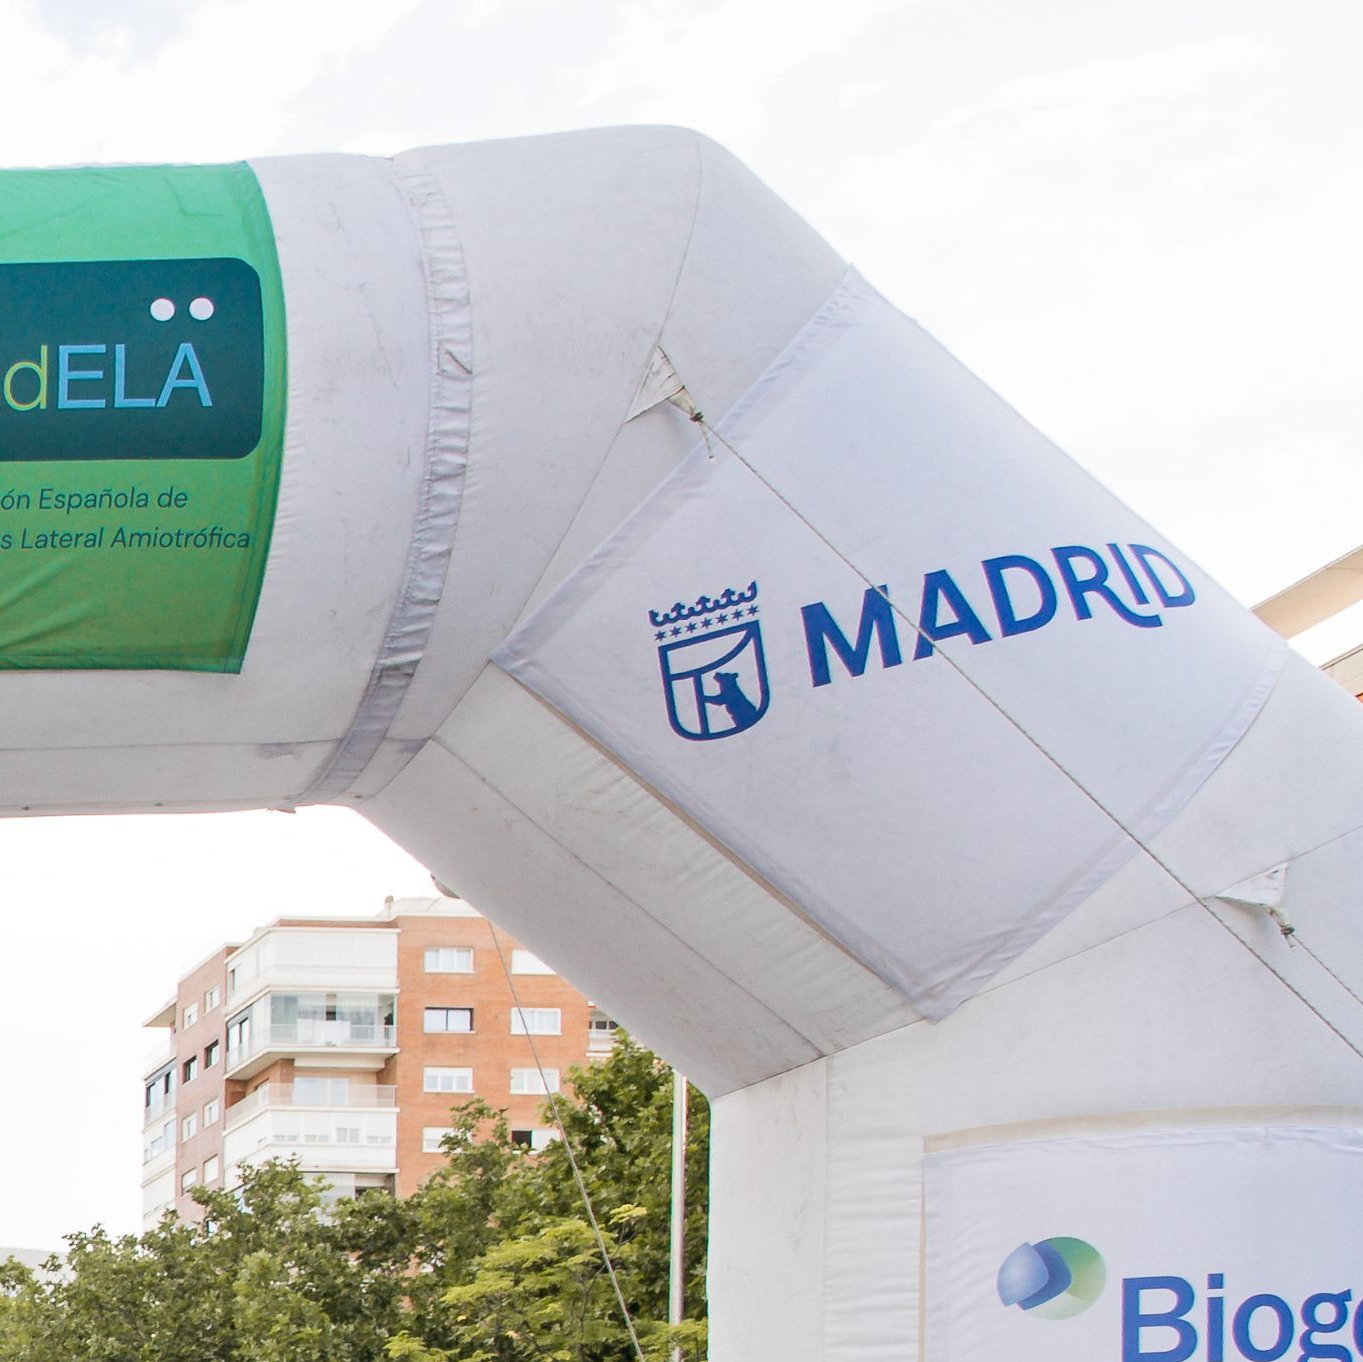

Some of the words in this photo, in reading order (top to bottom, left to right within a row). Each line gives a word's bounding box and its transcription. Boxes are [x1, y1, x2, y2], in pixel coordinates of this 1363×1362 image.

[39, 487, 150, 516] Española
[157, 486, 188, 508] de
[20, 526, 103, 551] Lateral
[110, 525, 252, 552] Amiotrófica
[800, 543, 1197, 688] MADRID
